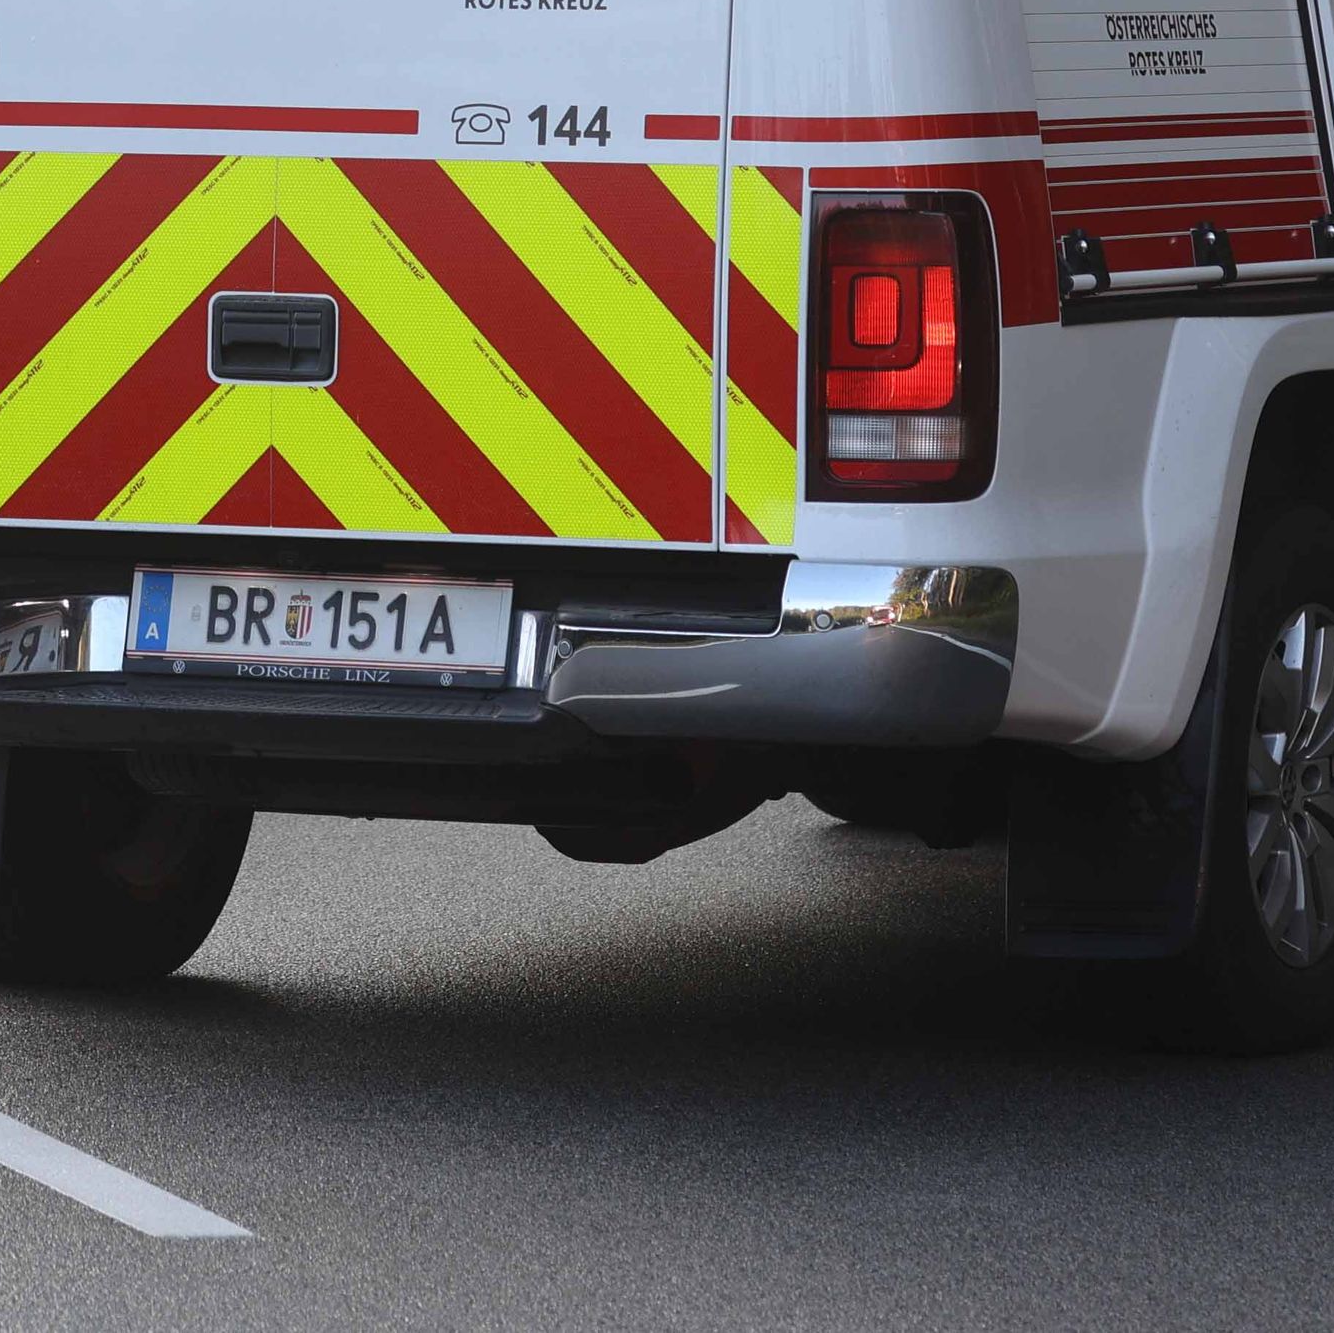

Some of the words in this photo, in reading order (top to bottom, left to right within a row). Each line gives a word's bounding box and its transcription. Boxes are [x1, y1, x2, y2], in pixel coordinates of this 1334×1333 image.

[1105, 13, 1218, 41] ÖSTERREICHISCHES
[1127, 50, 1166, 76] ROTES
[1166, 49, 1207, 76] KREUZ
[527, 103, 612, 148] 144
[206, 584, 277, 646] BR
[145, 621, 160, 640] A
[236, 663, 331, 681] PORSCHE
[344, 669, 391, 684] LINZ
